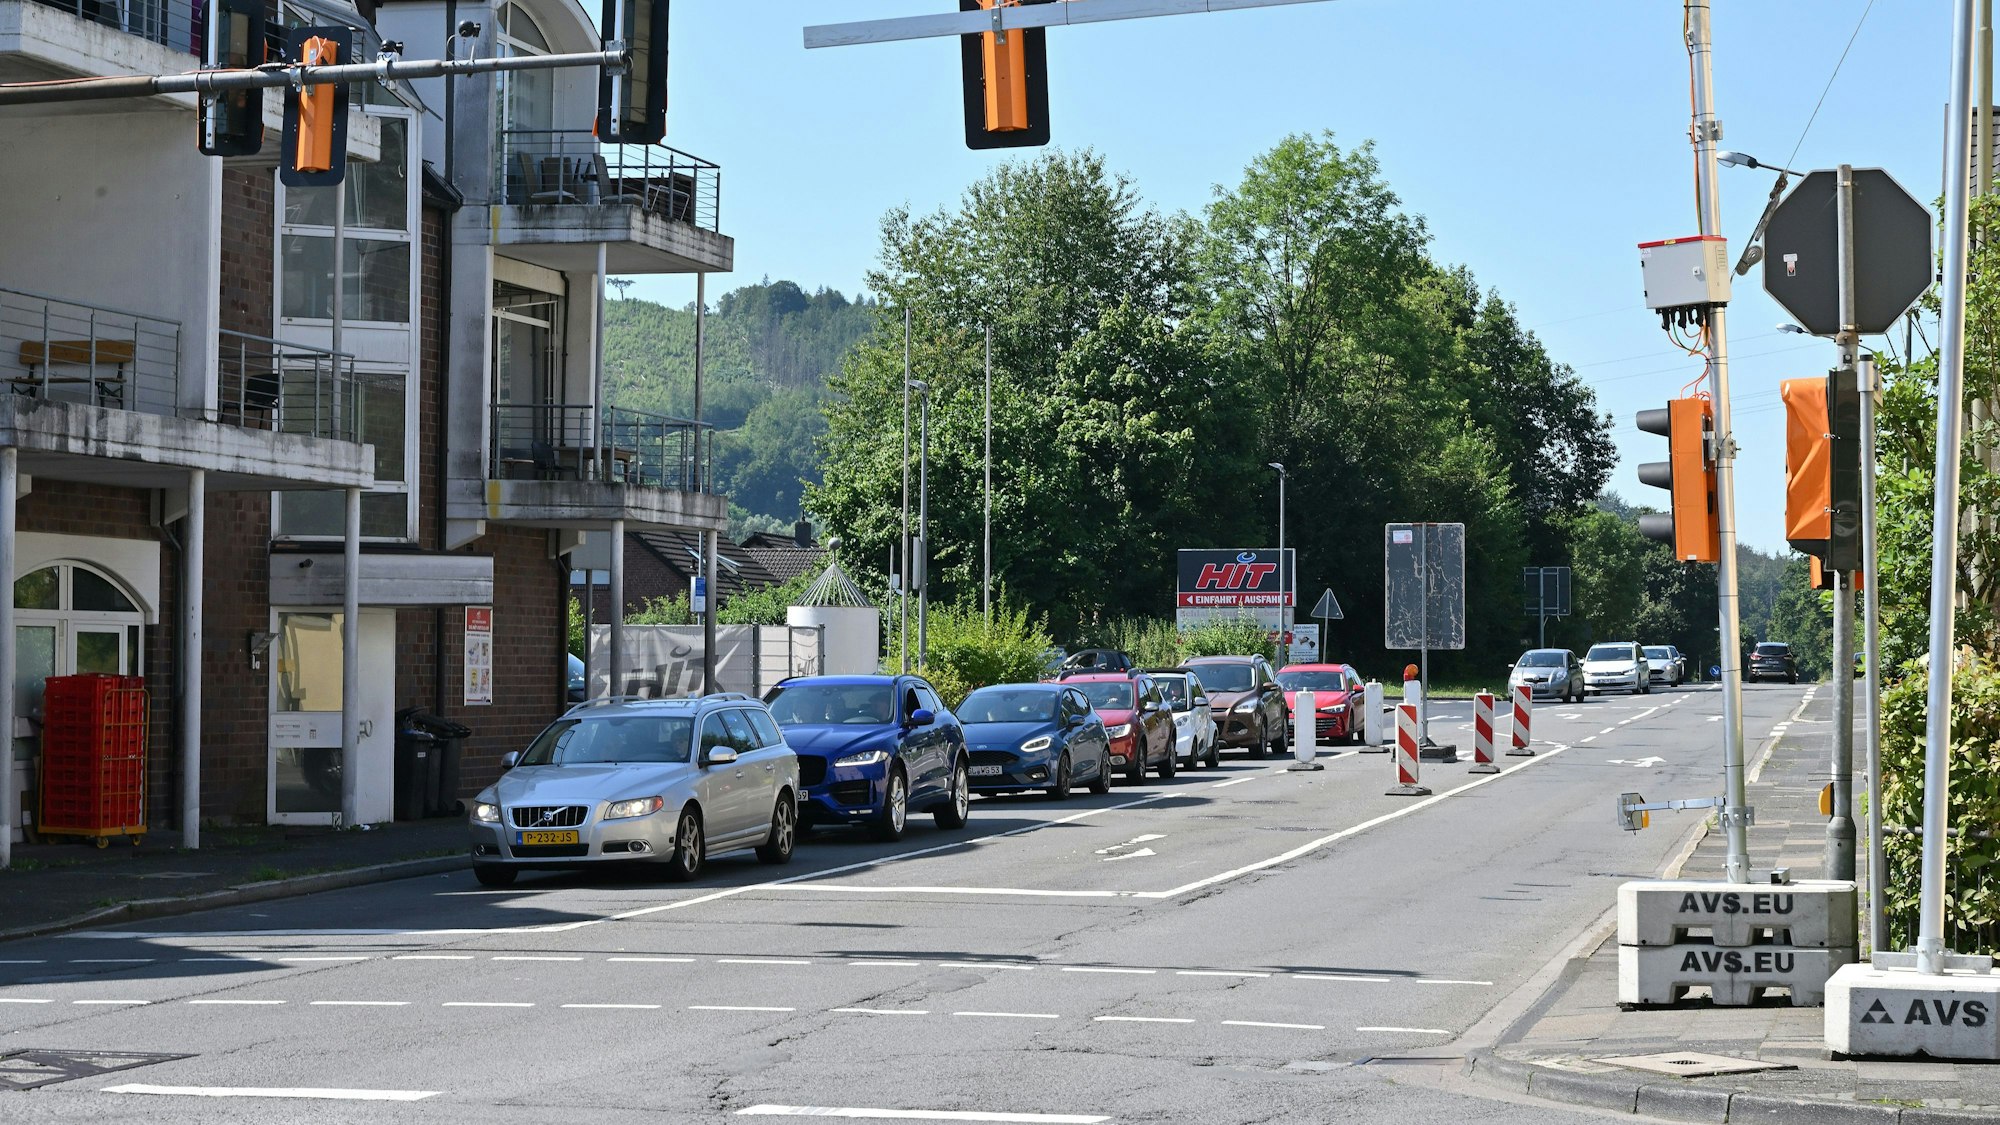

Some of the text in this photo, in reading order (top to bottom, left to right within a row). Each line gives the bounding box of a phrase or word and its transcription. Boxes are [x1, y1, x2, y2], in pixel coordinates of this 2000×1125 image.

[1195, 595, 1237, 604] EINFAHRT
[991, 766, 1000, 774] 53
[527, 832, 572, 843] P-232-JS
[1679, 892, 1793, 914] AVS.EU
[1680, 951, 1794, 973] AVS.EU
[1904, 998, 1988, 1027] AVS
